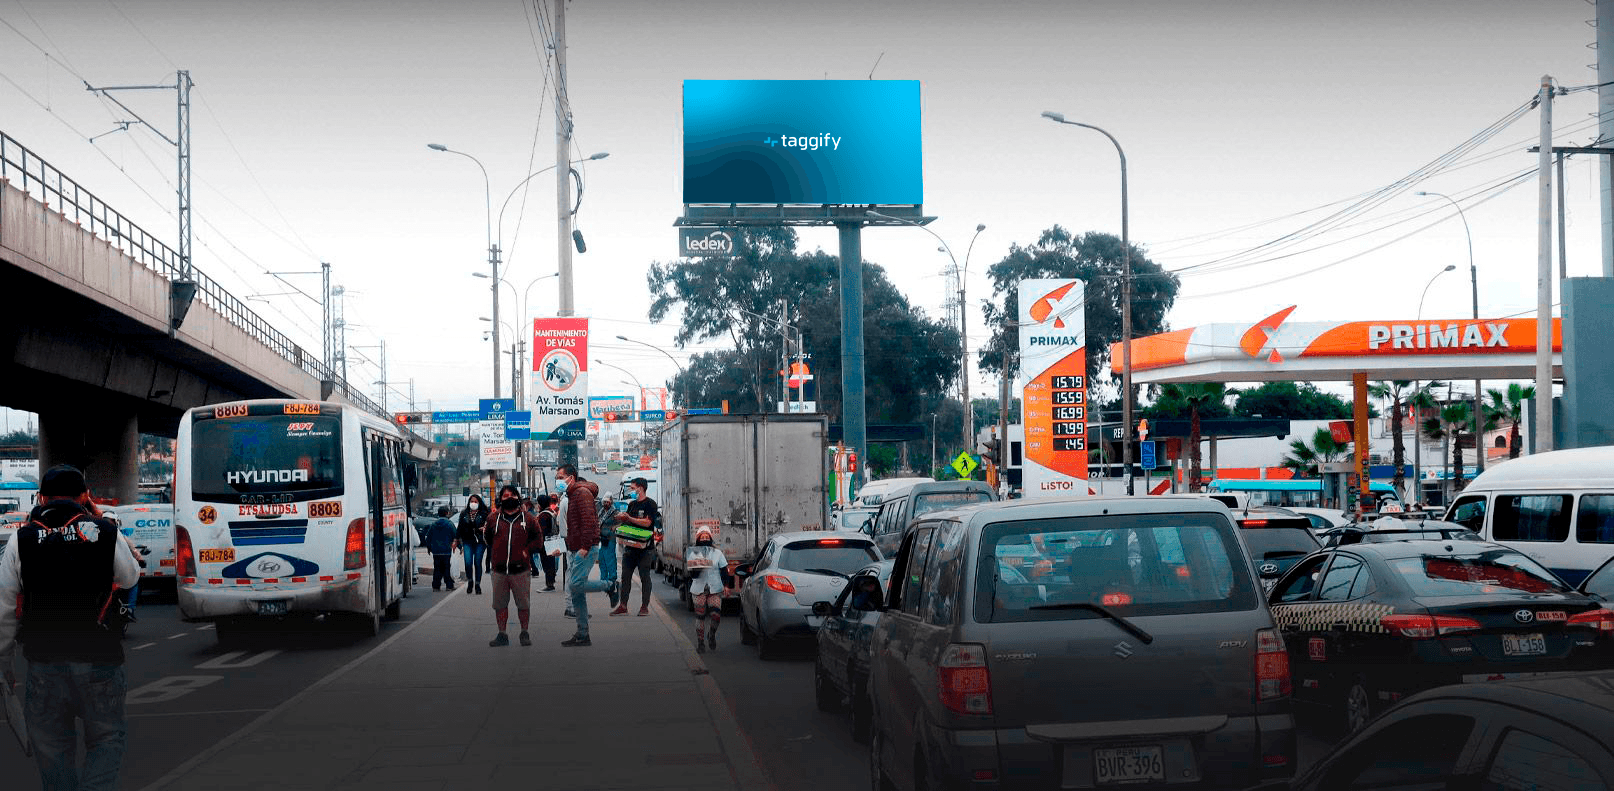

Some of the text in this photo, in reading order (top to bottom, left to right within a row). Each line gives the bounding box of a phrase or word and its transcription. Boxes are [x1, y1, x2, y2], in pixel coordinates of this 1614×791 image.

[781, 132, 841, 150] taggify
[686, 235, 726, 251] ledex
[546, 337, 576, 347] DE VÍAS
[1030, 336, 1078, 346] PRIMAX
[1369, 323, 1510, 350] PRIMAX
[536, 396, 584, 405] Av. Tomás
[217, 404, 247, 418] 8803
[285, 404, 319, 414] F8J-784
[539, 406, 580, 416] Marsano
[227, 469, 309, 484] HYUNDAI
[200, 509, 215, 520] 34
[239, 504, 298, 516] ETSAJUDSA
[310, 503, 340, 517] 8803
[200, 550, 234, 562] F8J-784
[1219, 640, 1248, 649] APV
[1504, 638, 1544, 654] BLI-158
[1117, 748, 1140, 756] PERU
[1097, 754, 1161, 777] BVR-396
